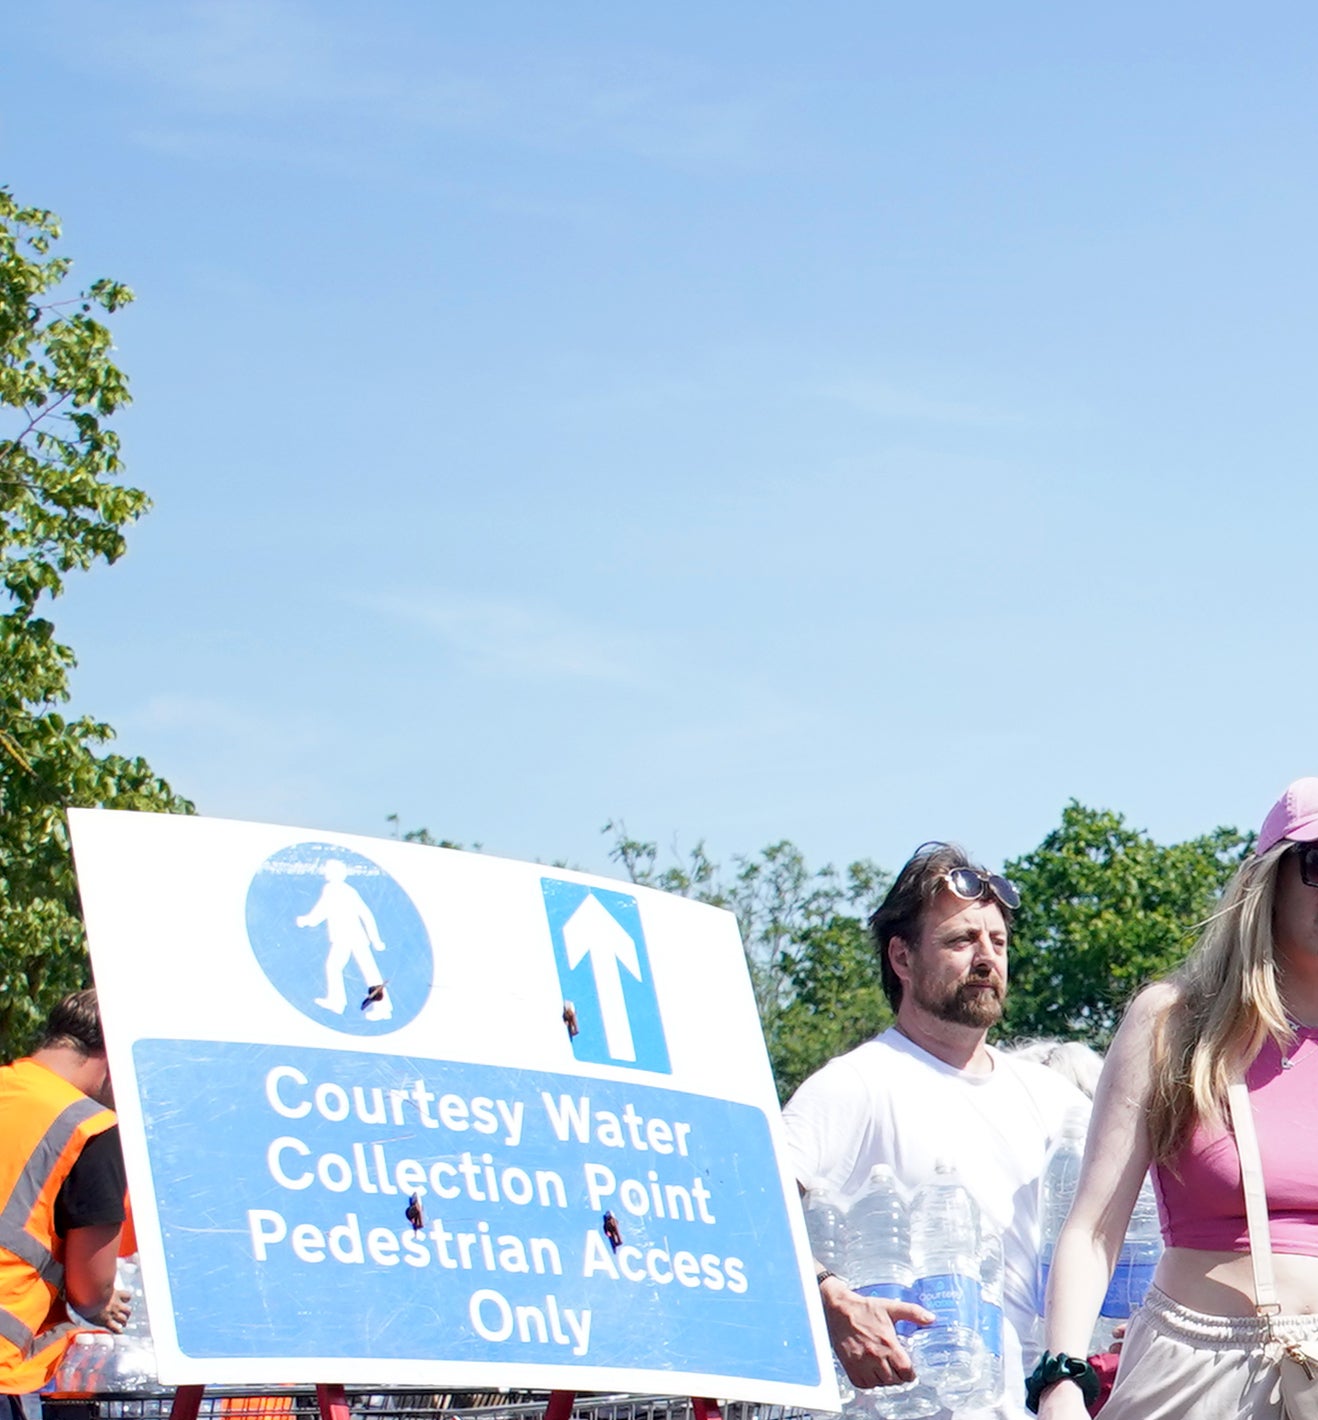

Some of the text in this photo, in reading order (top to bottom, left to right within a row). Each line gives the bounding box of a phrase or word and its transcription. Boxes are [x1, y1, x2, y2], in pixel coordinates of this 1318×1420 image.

[265, 1065, 693, 1157] Courtesy Water
[267, 1136, 717, 1225] Collection Point
[248, 1208, 749, 1294] Pedestrian Access
[468, 1289, 592, 1357] Only
